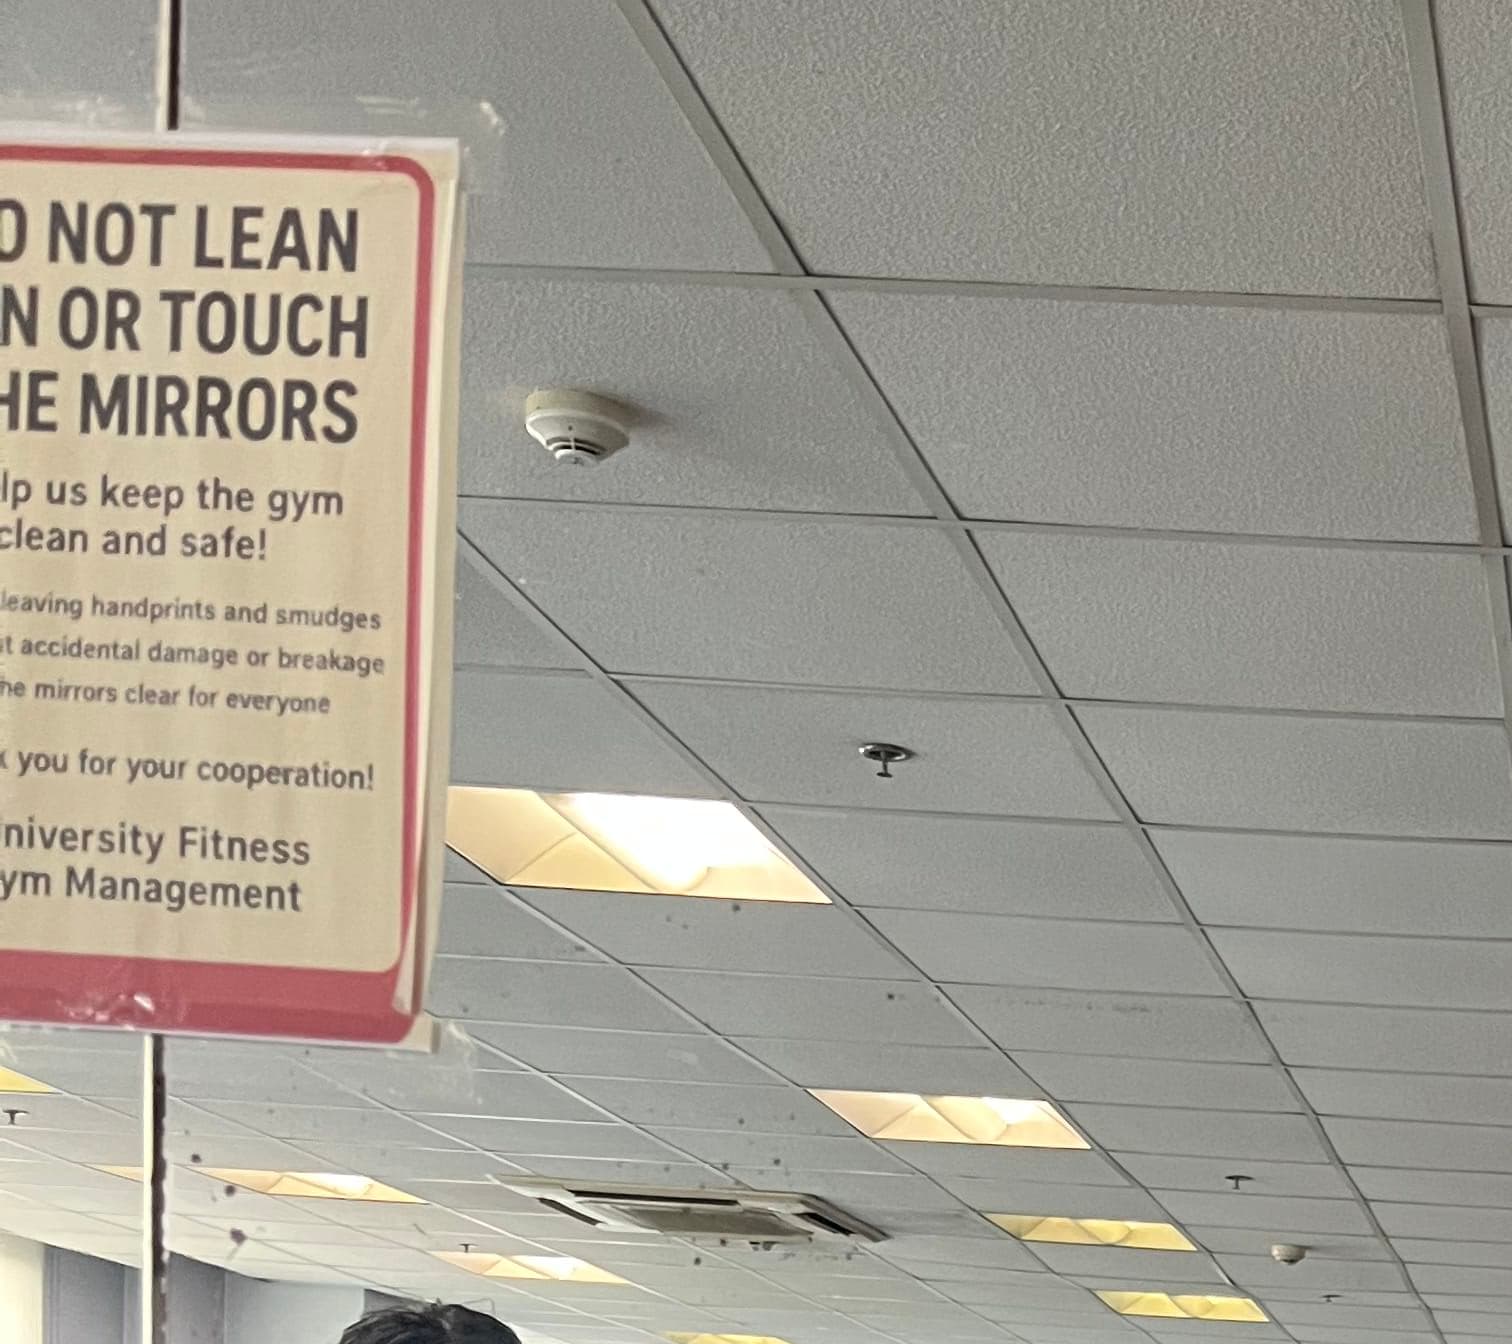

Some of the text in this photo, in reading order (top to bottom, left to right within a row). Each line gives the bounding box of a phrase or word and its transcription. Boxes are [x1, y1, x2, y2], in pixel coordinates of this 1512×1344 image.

[47, 199, 177, 267] NOT
[193, 204, 359, 273] LEAN
[58, 285, 142, 352] OR
[159, 289, 369, 359] TOUCH
[79, 372, 358, 444] MIRRORS
[46, 480, 88, 507] us
[100, 473, 185, 518] keep
[196, 476, 256, 511] the
[267, 489, 344, 523] gym
[0, 517, 266, 561] clean and safe!
[91, 593, 216, 625] handprints
[224, 602, 268, 625] and
[275, 605, 382, 633] smudges
[20, 636, 141, 661] accidental
[147, 642, 239, 670] damage
[246, 650, 270, 667] or
[277, 646, 385, 678] breakage
[34, 678, 118, 703] mirrors
[124, 682, 181, 706] clear
[188, 684, 219, 708] for
[225, 692, 331, 717] everyone
[17, 750, 69, 777] you
[78, 747, 117, 776] for
[126, 757, 187, 785] your
[196, 760, 374, 791] cooperation!
[179, 825, 310, 866] Fitness
[65, 866, 302, 913] Management
